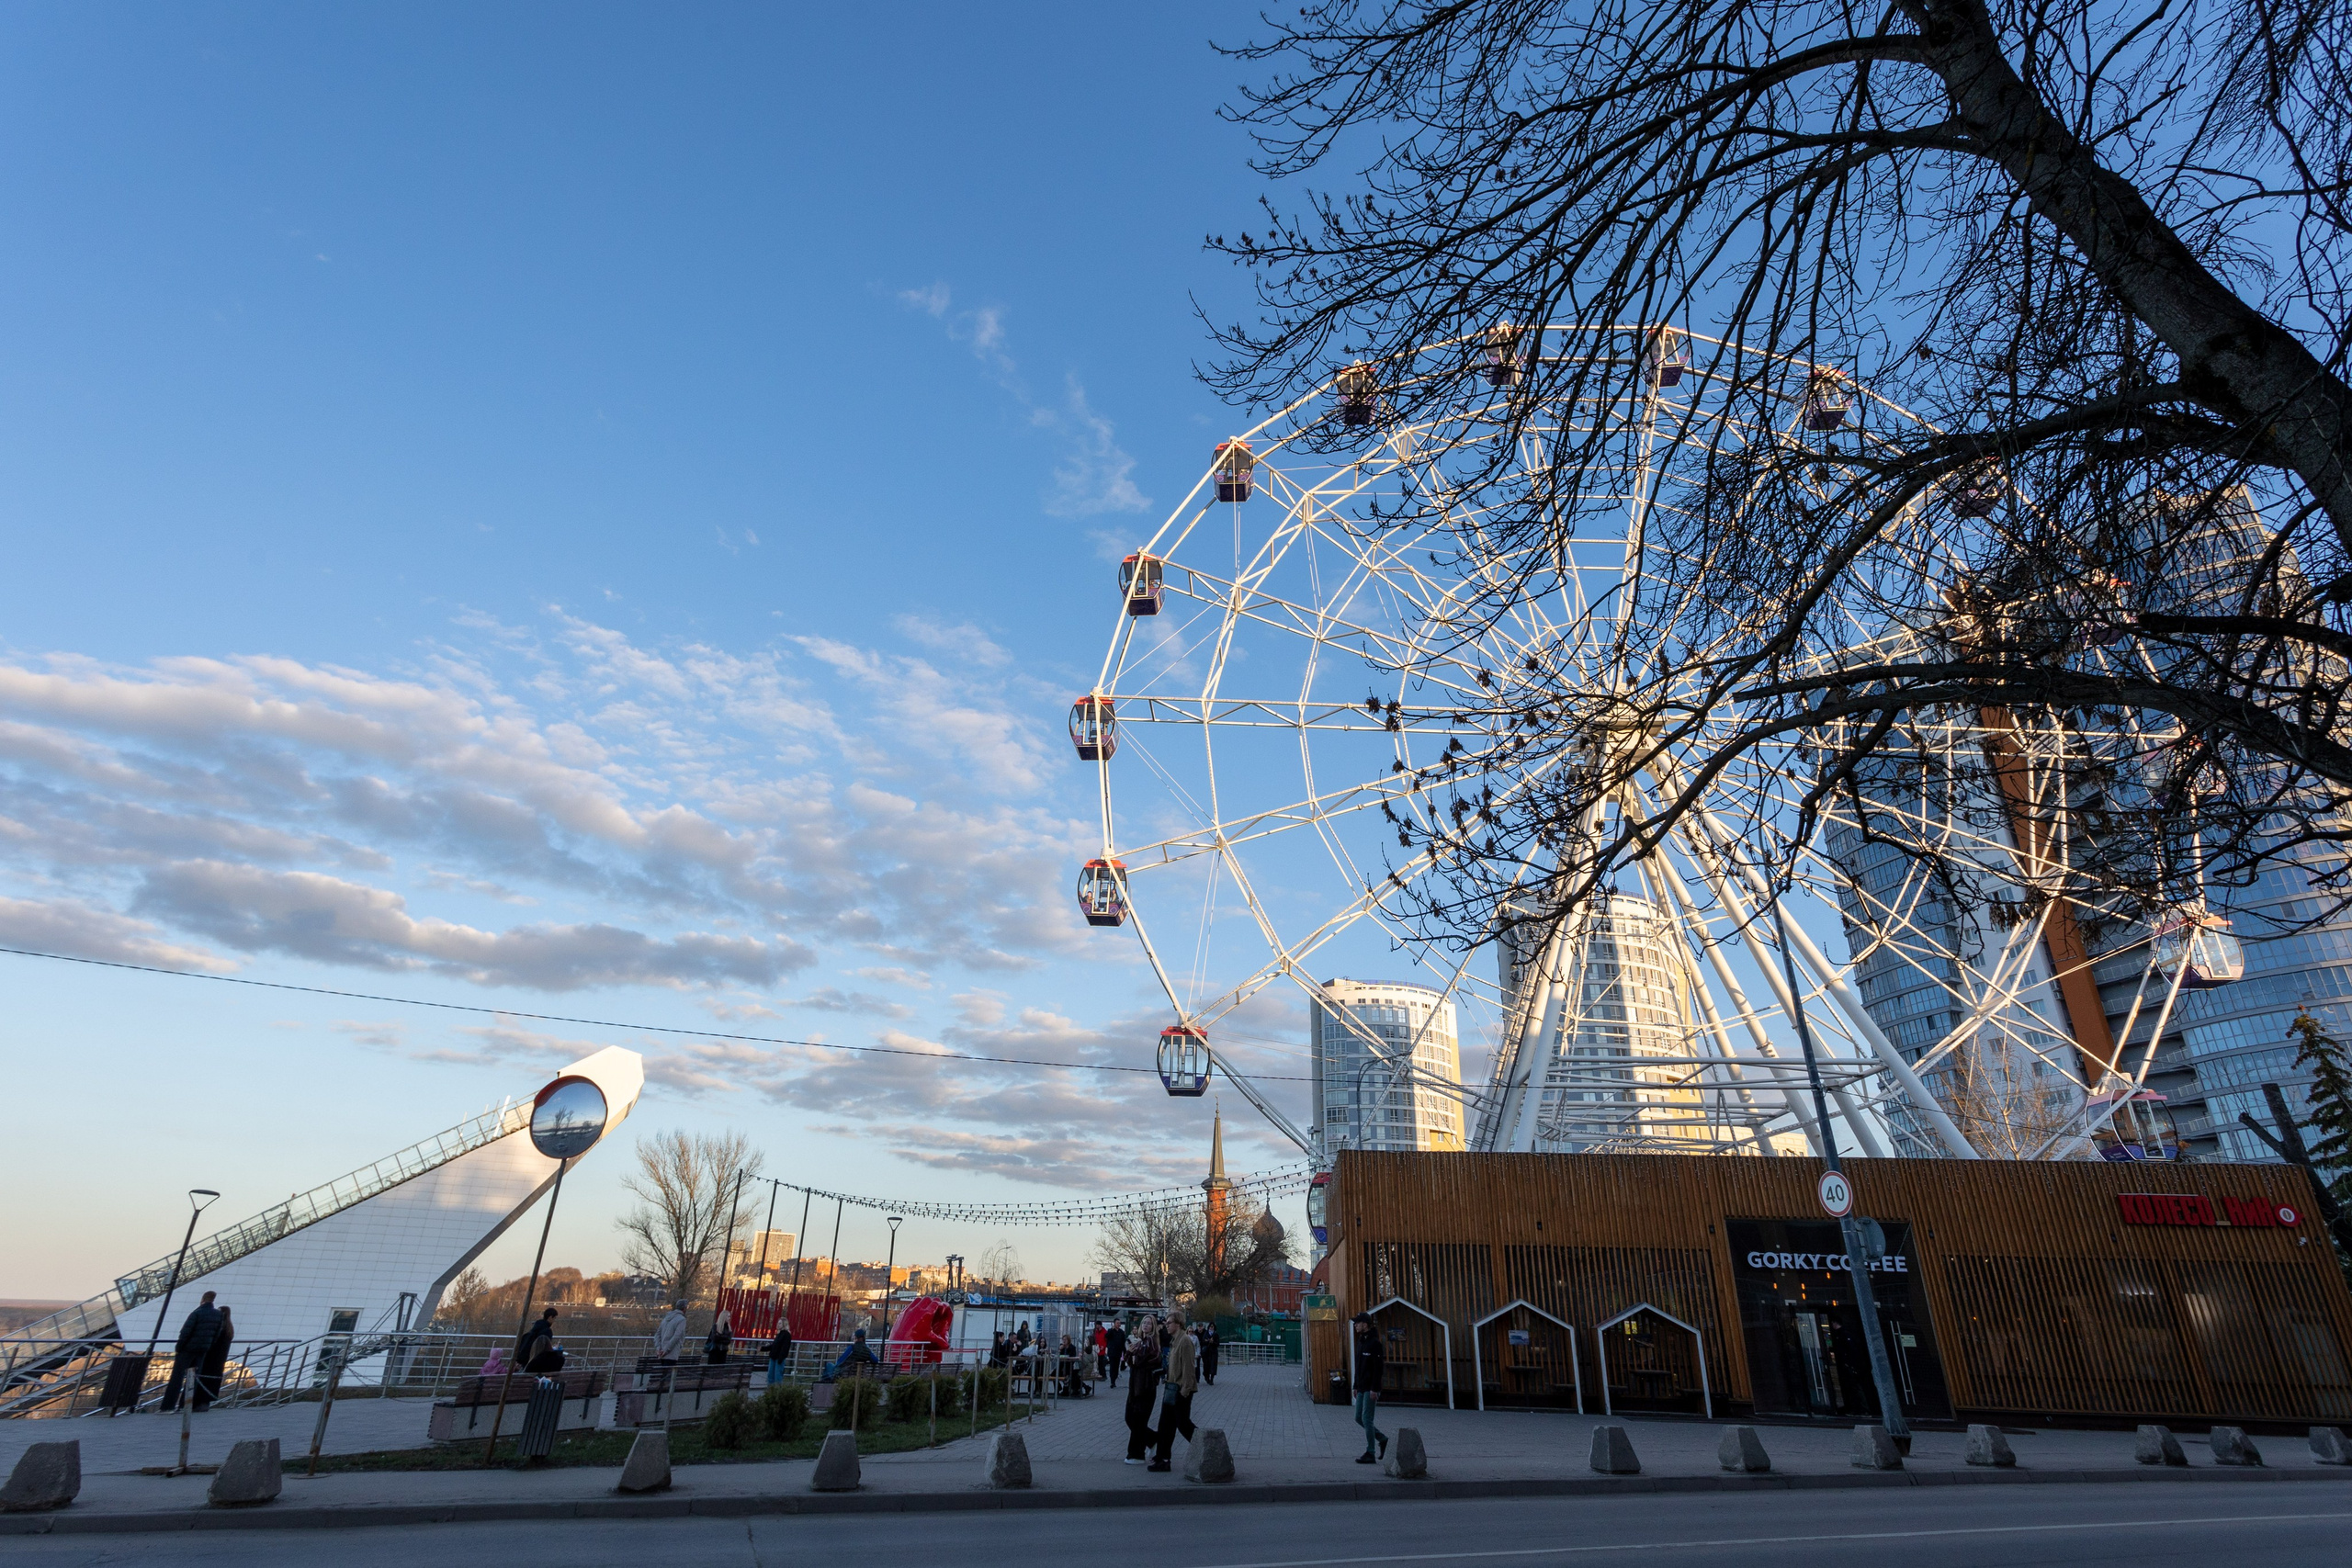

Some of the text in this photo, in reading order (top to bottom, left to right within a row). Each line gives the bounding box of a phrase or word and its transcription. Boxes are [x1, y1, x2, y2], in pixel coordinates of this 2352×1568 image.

[1826, 1184, 1845, 1203] 40
[1747, 1250, 1909, 1273] GORKY COFEE
